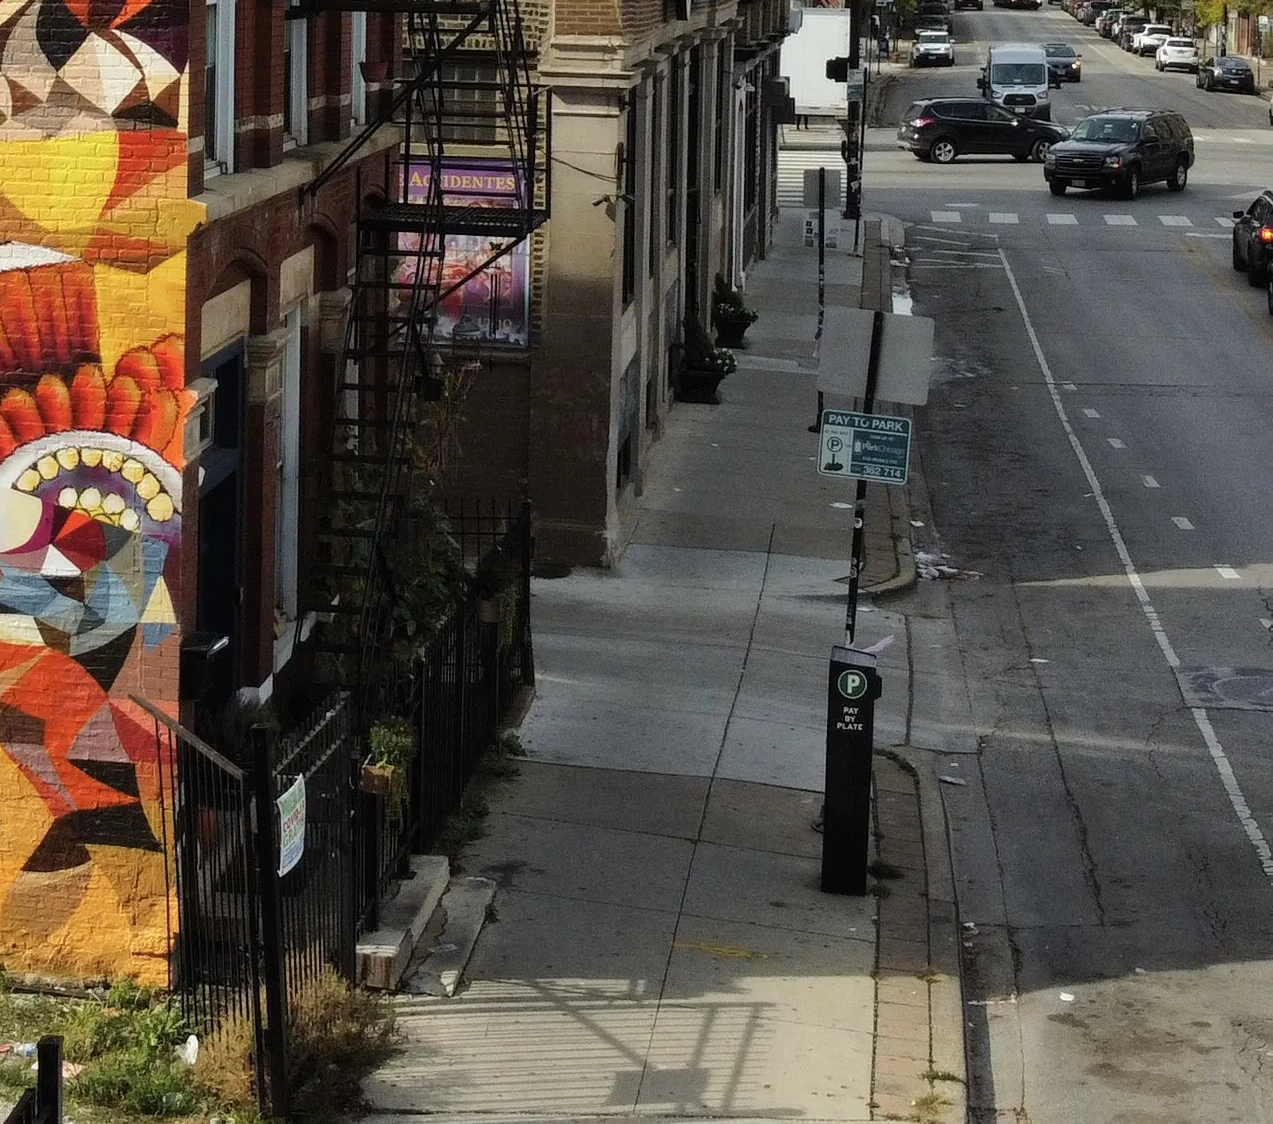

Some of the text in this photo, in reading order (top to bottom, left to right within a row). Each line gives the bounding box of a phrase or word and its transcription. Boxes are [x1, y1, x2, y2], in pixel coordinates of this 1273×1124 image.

[410, 170, 516, 191] ACIDENTES
[828, 414, 903, 432] PAY TO PARK
[883, 468, 902, 478] 714
[847, 674, 861, 694] P
[843, 706, 859, 715] PAY
[844, 715, 856, 723] BY
[836, 722, 863, 731] PLATE
